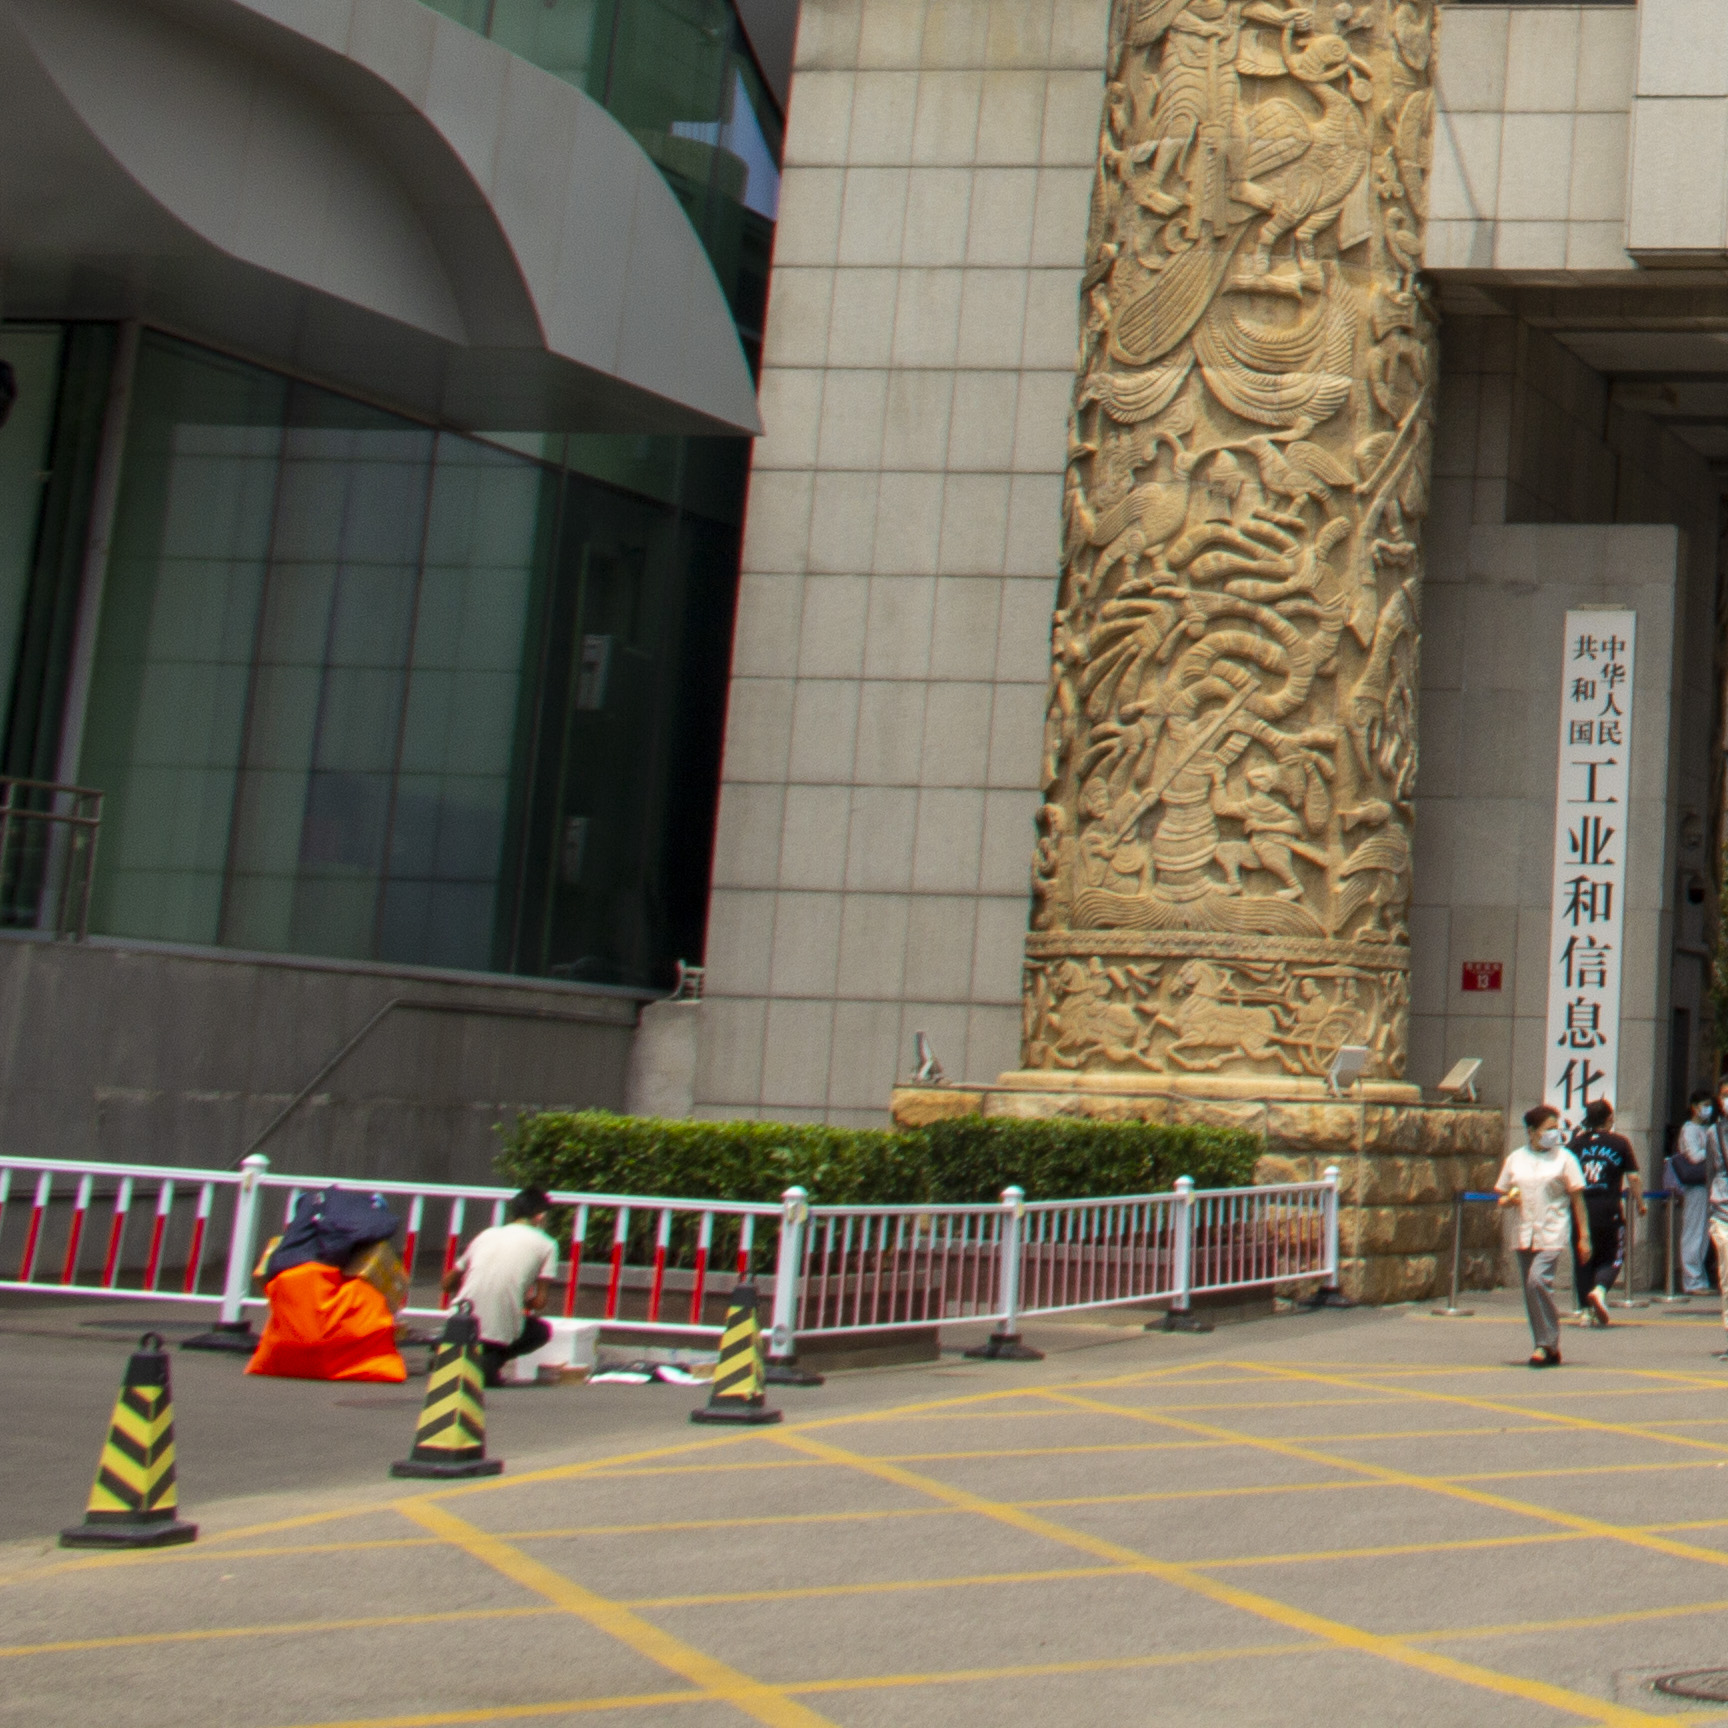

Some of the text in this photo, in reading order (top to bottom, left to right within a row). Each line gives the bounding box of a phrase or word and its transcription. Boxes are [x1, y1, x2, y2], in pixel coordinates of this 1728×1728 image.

[1568, 634, 1599, 746] 共和国
[1597, 634, 1626, 747] 中华人民
[1555, 757, 1621, 1146] 工业和信息化
